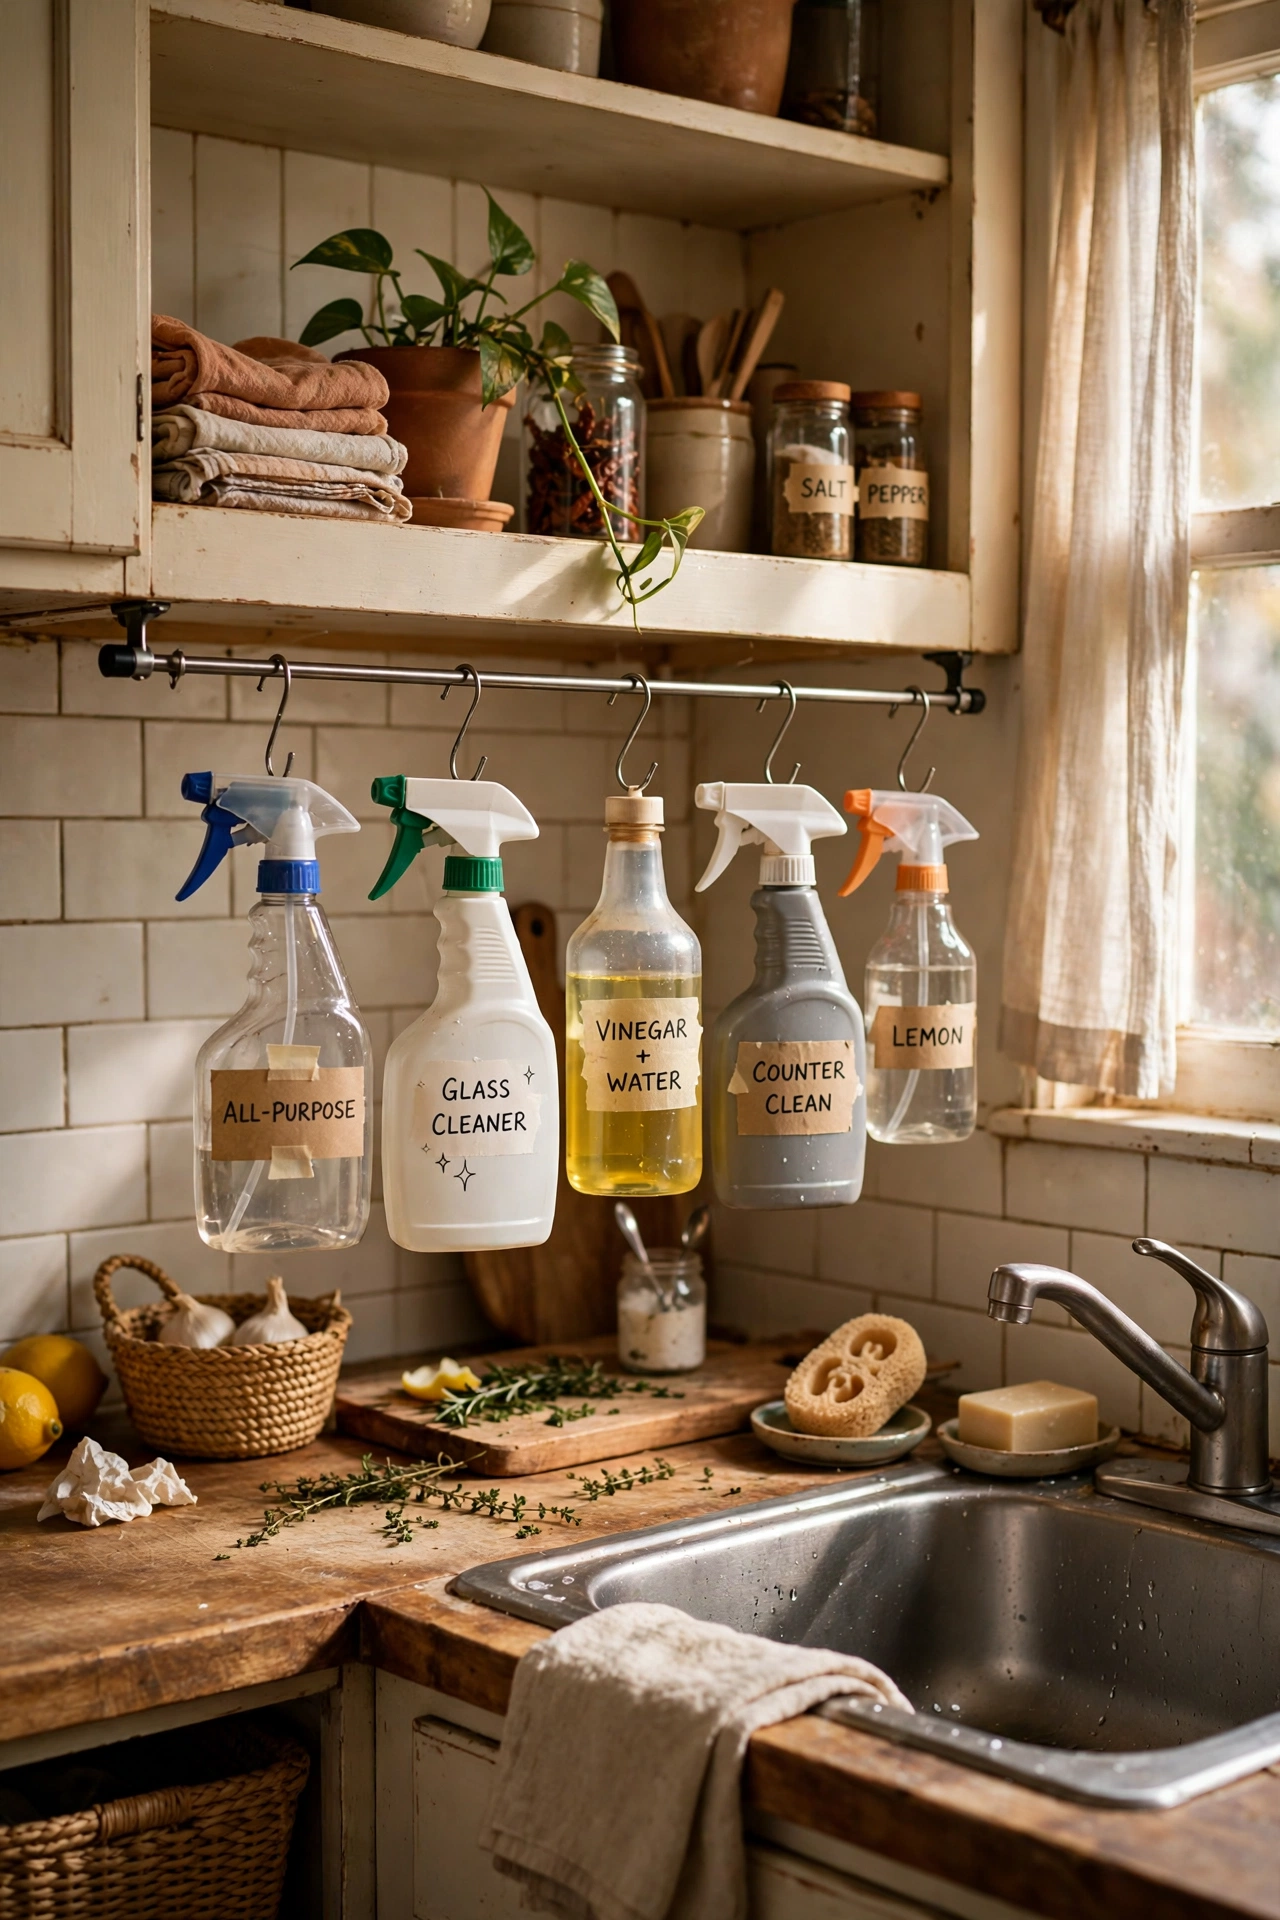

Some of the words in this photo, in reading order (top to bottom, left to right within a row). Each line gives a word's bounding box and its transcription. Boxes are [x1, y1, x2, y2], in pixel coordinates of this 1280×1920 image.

[801, 477, 847, 499] SALT
[867, 483, 926, 505] PEPPER
[595, 1017, 688, 1042] VINEGAR
[892, 1024, 963, 1048] LEMON
[635, 1048, 651, 1064] +
[606, 1069, 682, 1093] WATER
[752, 1060, 846, 1083] COUNTER
[441, 1077, 511, 1101] GLASS
[222, 1099, 356, 1125] ALL-PURPOSE
[765, 1093, 832, 1115] CLEAN
[431, 1111, 527, 1136] CLEANER
